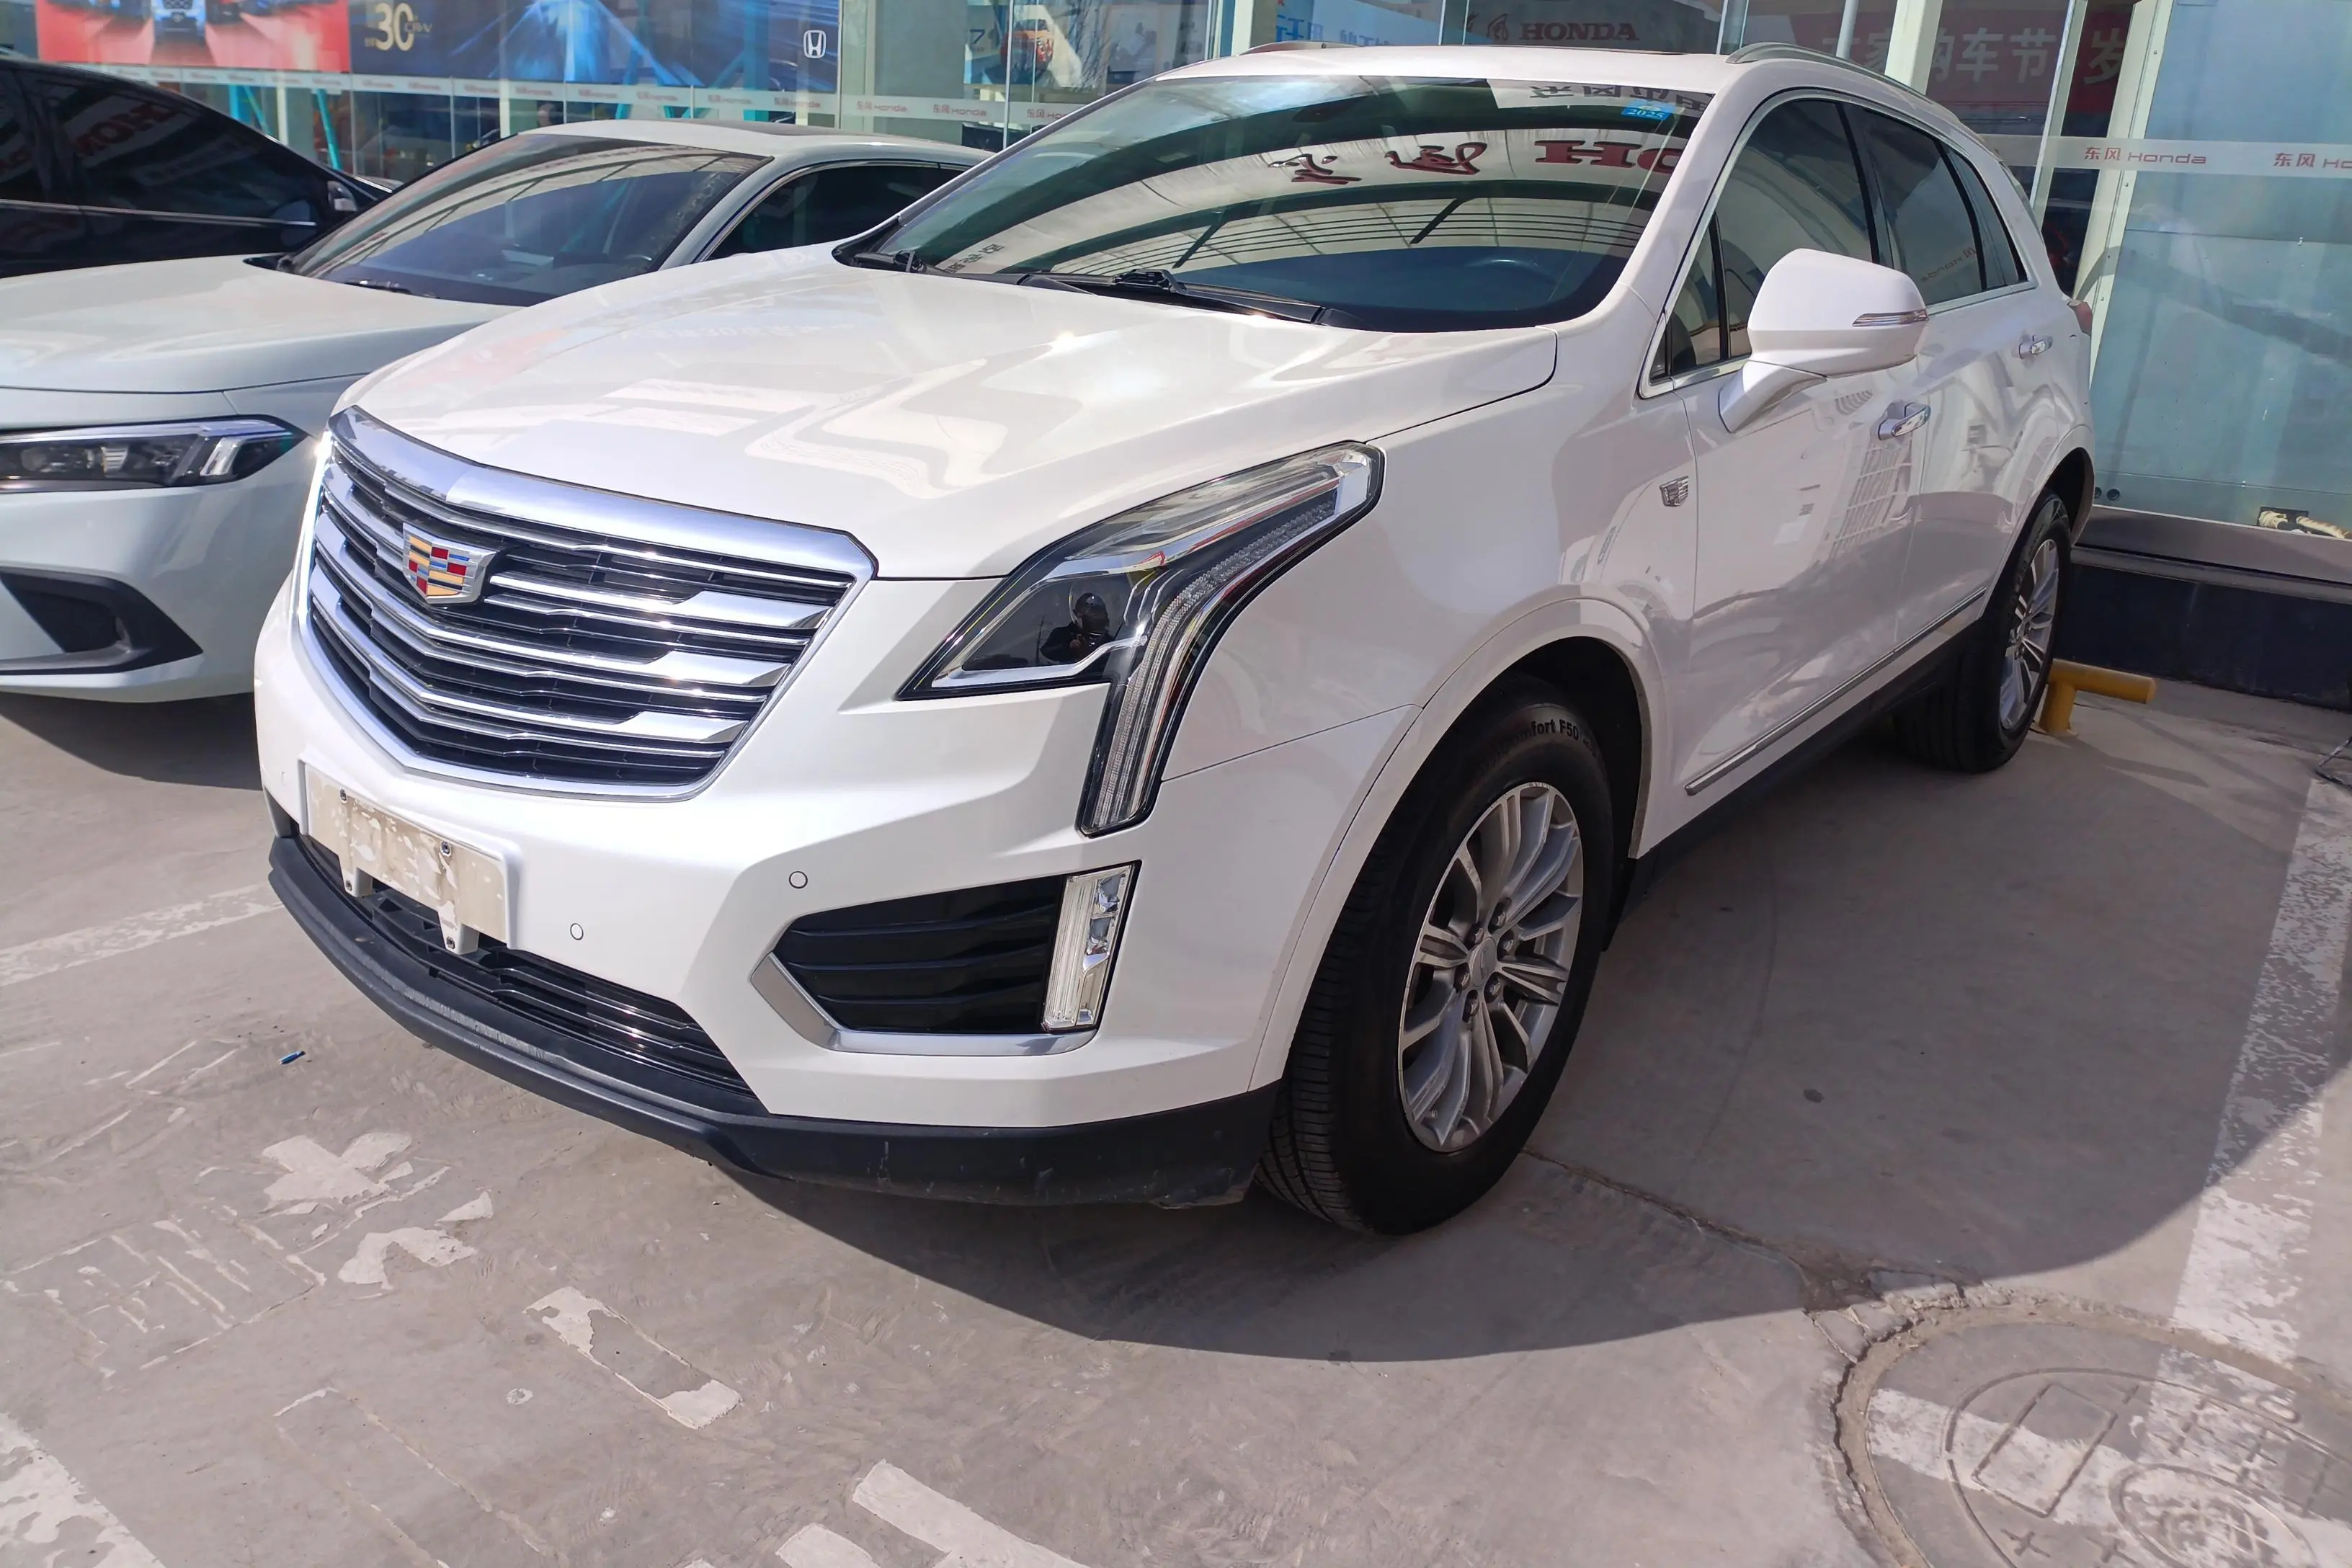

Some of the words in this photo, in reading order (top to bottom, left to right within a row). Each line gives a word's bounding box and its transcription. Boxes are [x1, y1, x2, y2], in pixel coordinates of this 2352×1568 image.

[375, 3, 415, 51] 30
[1519, 22, 1640, 41] HONDA
[951, 108, 987, 117] Honda
[1627, 108, 1664, 120] 2025
[2085, 146, 2121, 161] 东风
[2127, 151, 2207, 164] Honda
[2273, 152, 2316, 167] 东风
[1559, 719, 1580, 741] F50
